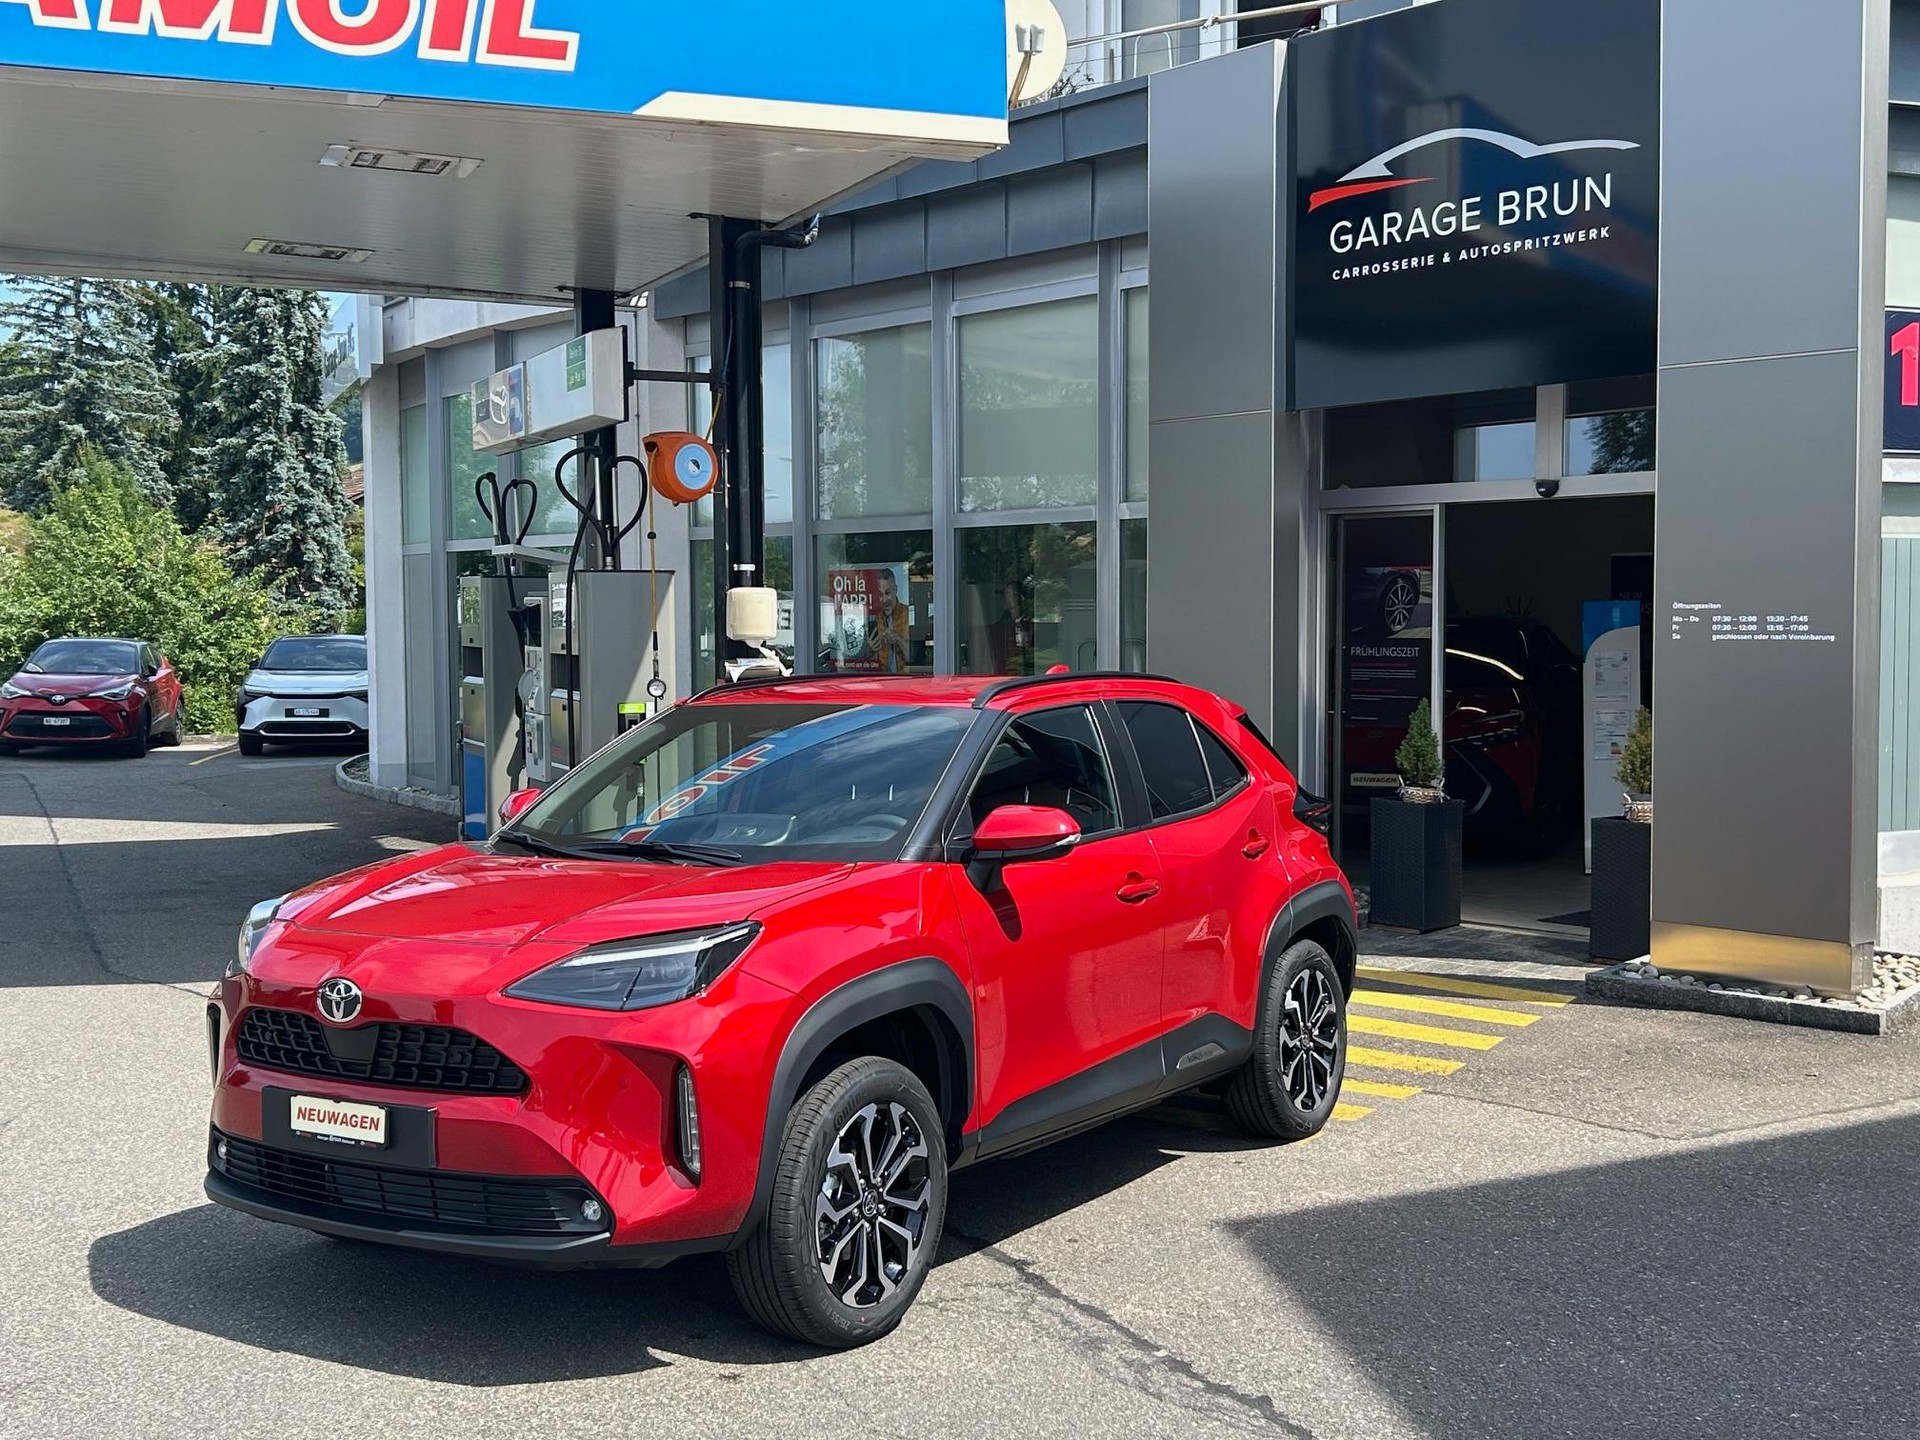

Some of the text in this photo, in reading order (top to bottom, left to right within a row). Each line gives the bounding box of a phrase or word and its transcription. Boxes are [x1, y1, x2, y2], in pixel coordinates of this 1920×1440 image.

[0, 0, 580, 72] OIL
[1329, 172, 1612, 254] GARAGE BRUN
[1332, 226, 1611, 281] CARROSSERIE & AUTOSPRITZWERK
[833, 576, 866, 592] Oh la
[1672, 601, 1722, 610] Öffnungszeiten
[1712, 634, 1752, 642] geschlossen
[1788, 634, 1836, 642] Vereinbarung
[1350, 646, 1420, 657] FRÜHLINGSZEIT
[296, 1106, 381, 1131] NEUWAGEN
